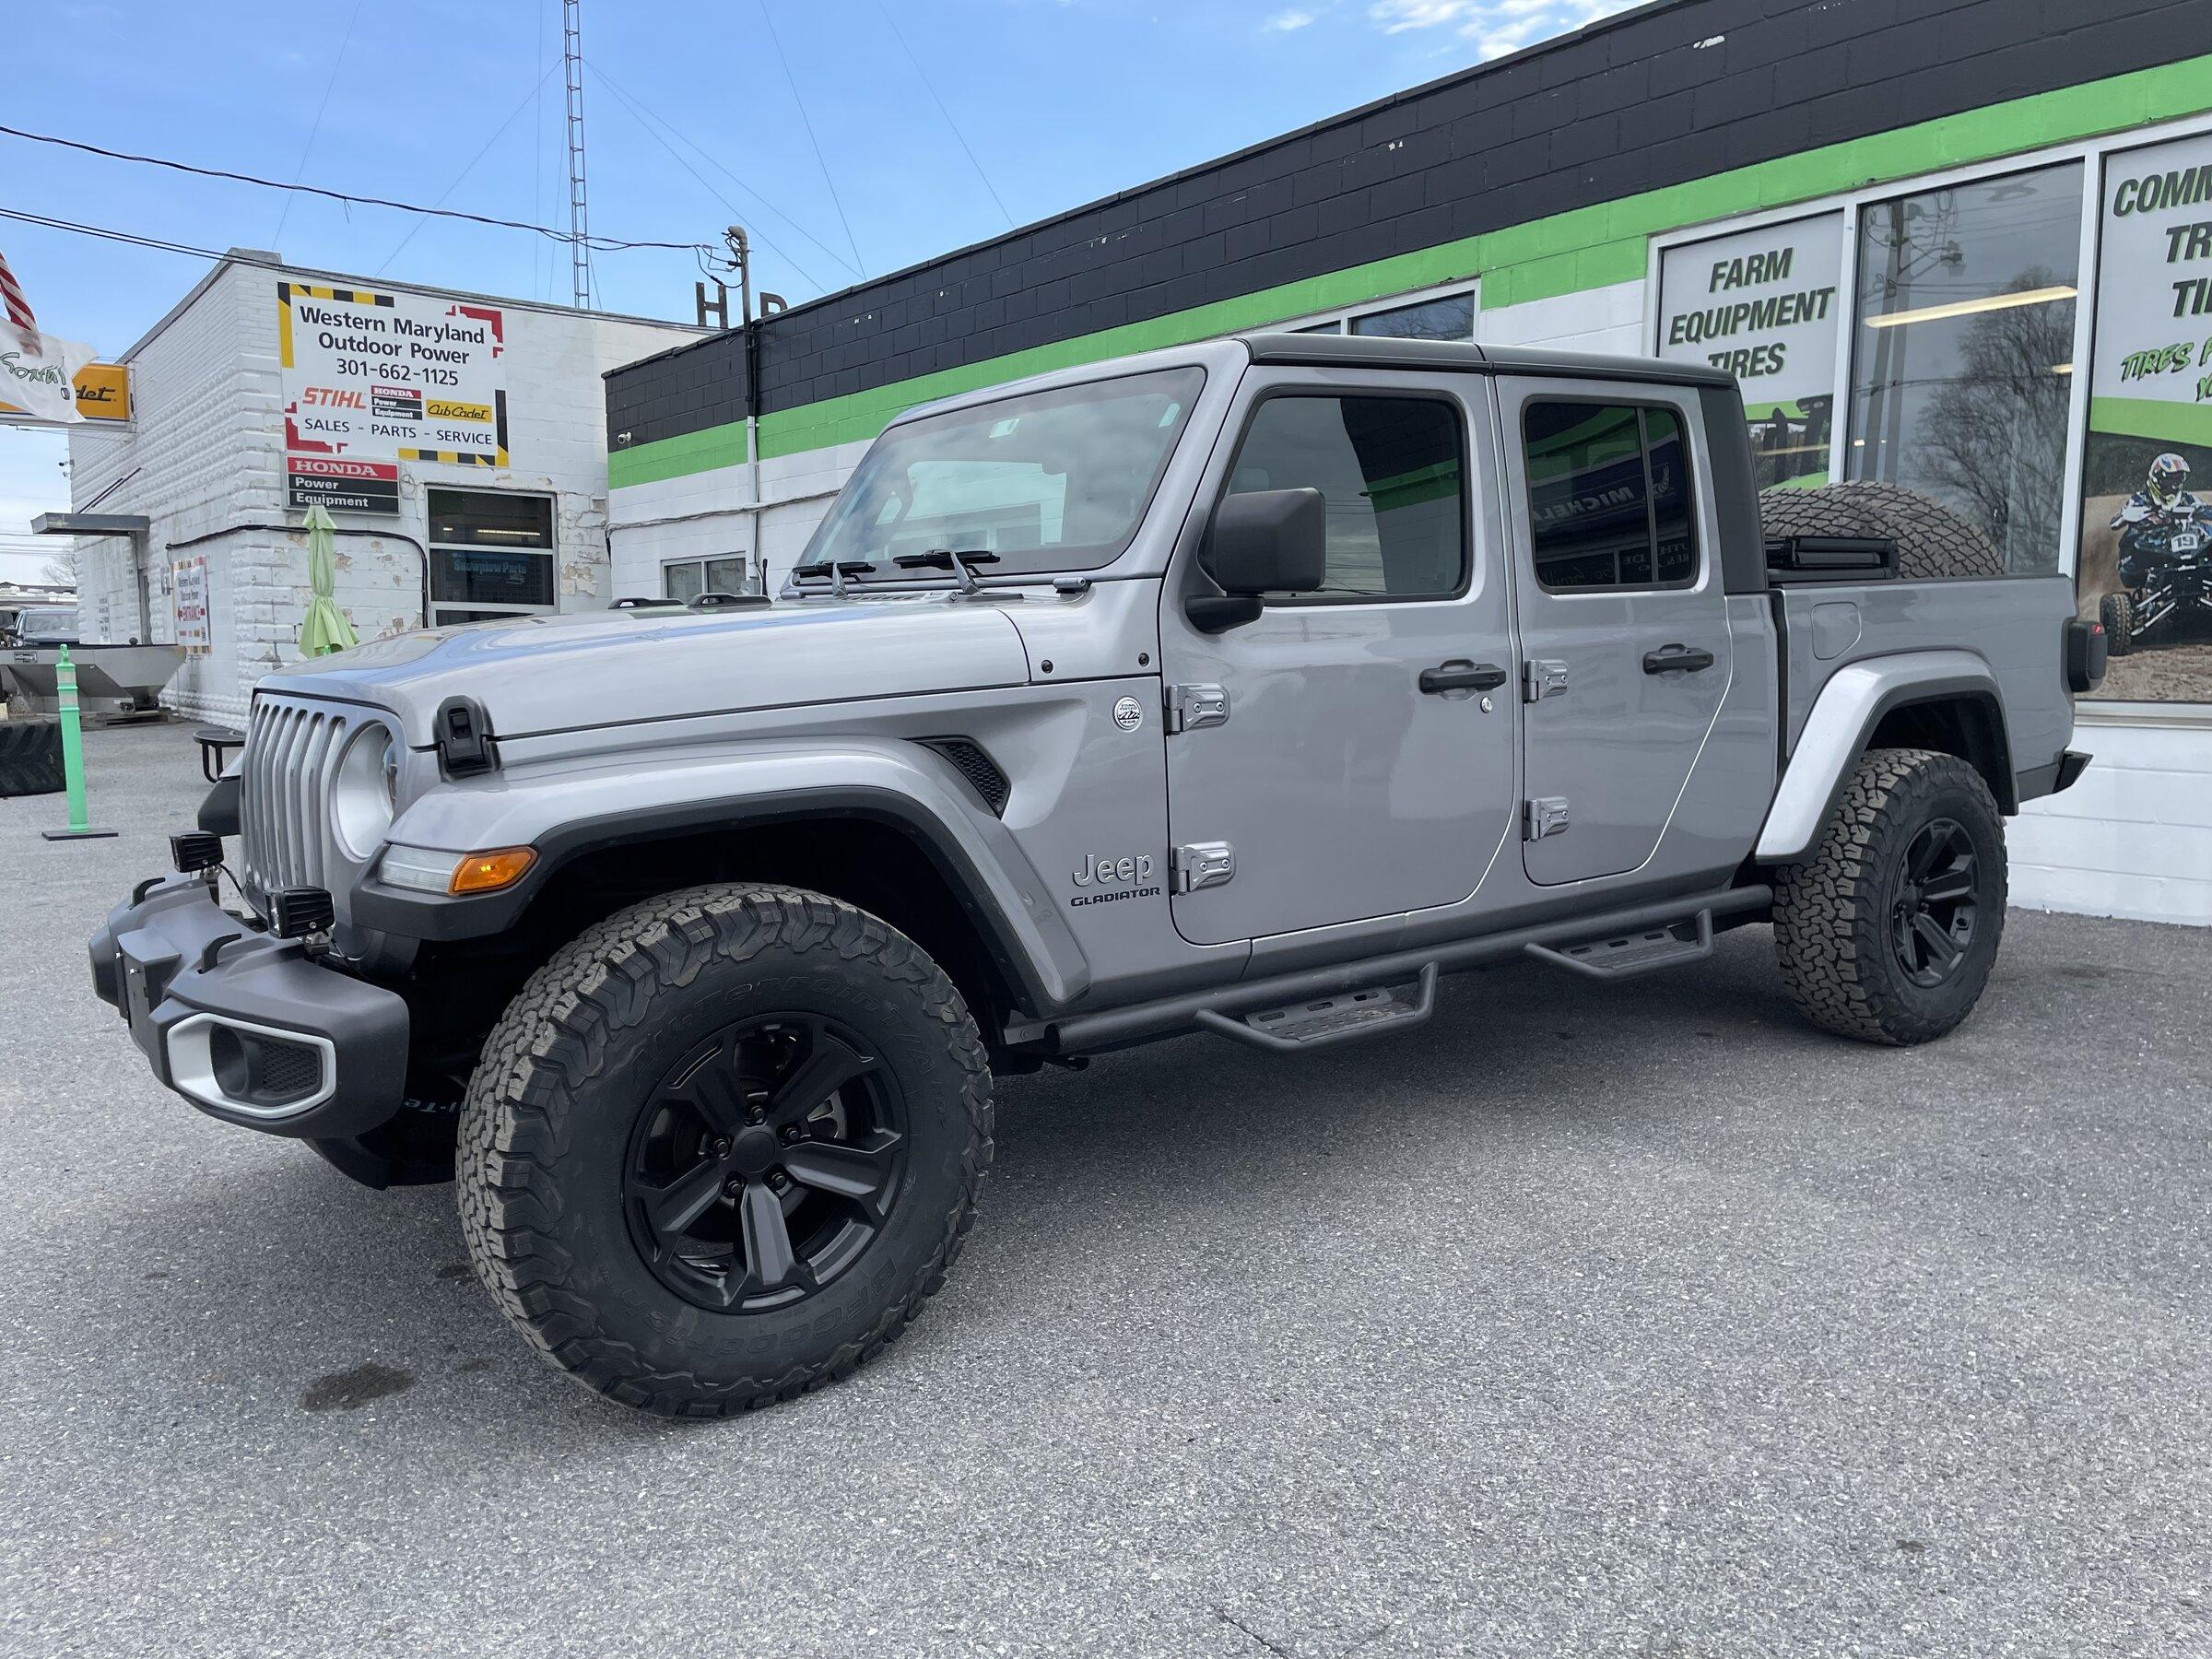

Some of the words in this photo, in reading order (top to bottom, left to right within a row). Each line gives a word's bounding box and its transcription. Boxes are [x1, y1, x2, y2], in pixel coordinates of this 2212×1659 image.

[1709, 247, 1794, 293] FARM
[300, 306, 386, 333] Western
[394, 318, 485, 345] Maryland
[1669, 287, 1835, 345] EQUIPMENT
[318, 332, 403, 358] Outdoor
[410, 342, 469, 365] Power
[336, 358, 459, 385] 301-662-1125
[1708, 342, 1786, 379] TIRES
[2121, 342, 2194, 382] TIRES
[301, 386, 367, 409] STIHL
[372, 387, 414, 398] HONDA
[373, 397, 397, 407] Power
[374, 408, 414, 418] Equipment
[428, 404, 451, 417] Cub
[451, 406, 488, 419] Cadet
[304, 418, 350, 433] SALES
[371, 423, 417, 439] PARTS
[436, 429, 492, 444] SERVICE
[295, 460, 379, 477] HONDA
[295, 477, 339, 489] Power
[296, 492, 369, 507] Equipment
[2174, 535, 2194, 548] 19
[1072, 853, 1155, 887] Jeep
[1070, 887, 1161, 907] GLADIATOR
